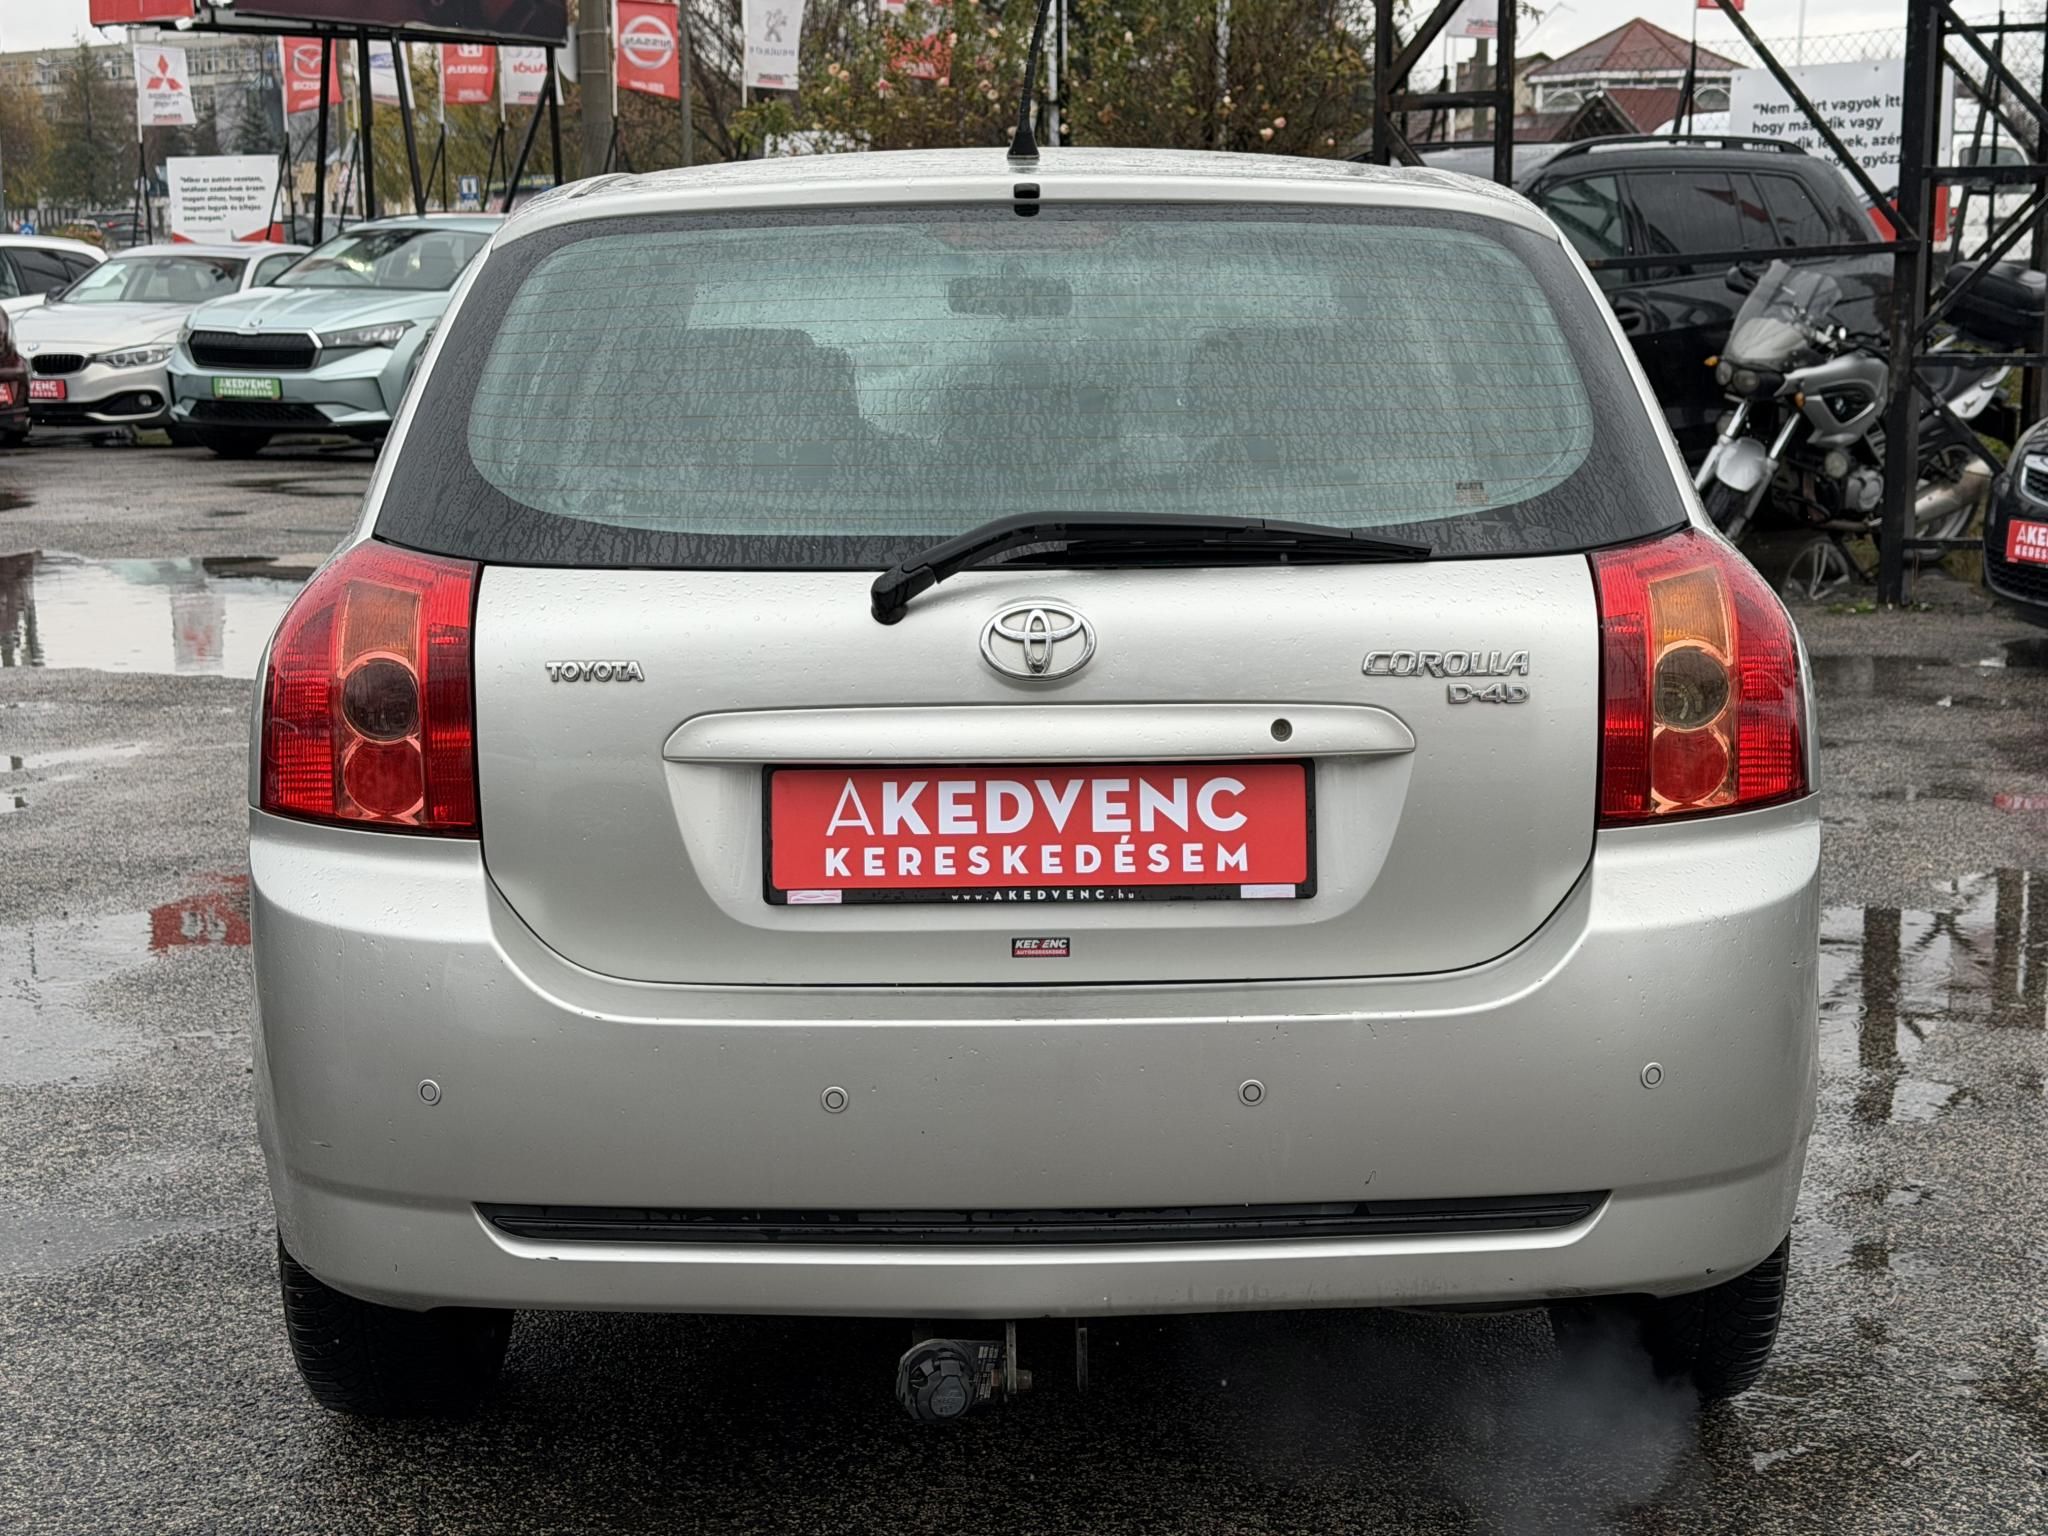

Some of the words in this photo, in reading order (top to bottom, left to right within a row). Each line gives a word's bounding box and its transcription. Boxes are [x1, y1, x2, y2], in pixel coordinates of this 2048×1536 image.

[1831, 96, 1881, 113] vagyok
[1752, 122, 1785, 136] hogy
[1788, 116, 1845, 132] mádik
[1850, 117, 1883, 131] vagy
[1817, 134, 1868, 150] leek,
[219, 378, 272, 390] AKEDVENC
[2016, 523, 2048, 547] AKE
[545, 660, 645, 682] TOYOTA
[1362, 650, 1530, 678] COROLLA
[1447, 682, 1531, 705] D-4D
[825, 776, 1247, 836] AKEDVENC
[825, 835, 1249, 878] KERESKEDÉSEM
[951, 888, 1135, 901] www.AKEDVENC.hu
[1014, 939, 1068, 949] KEDENC
